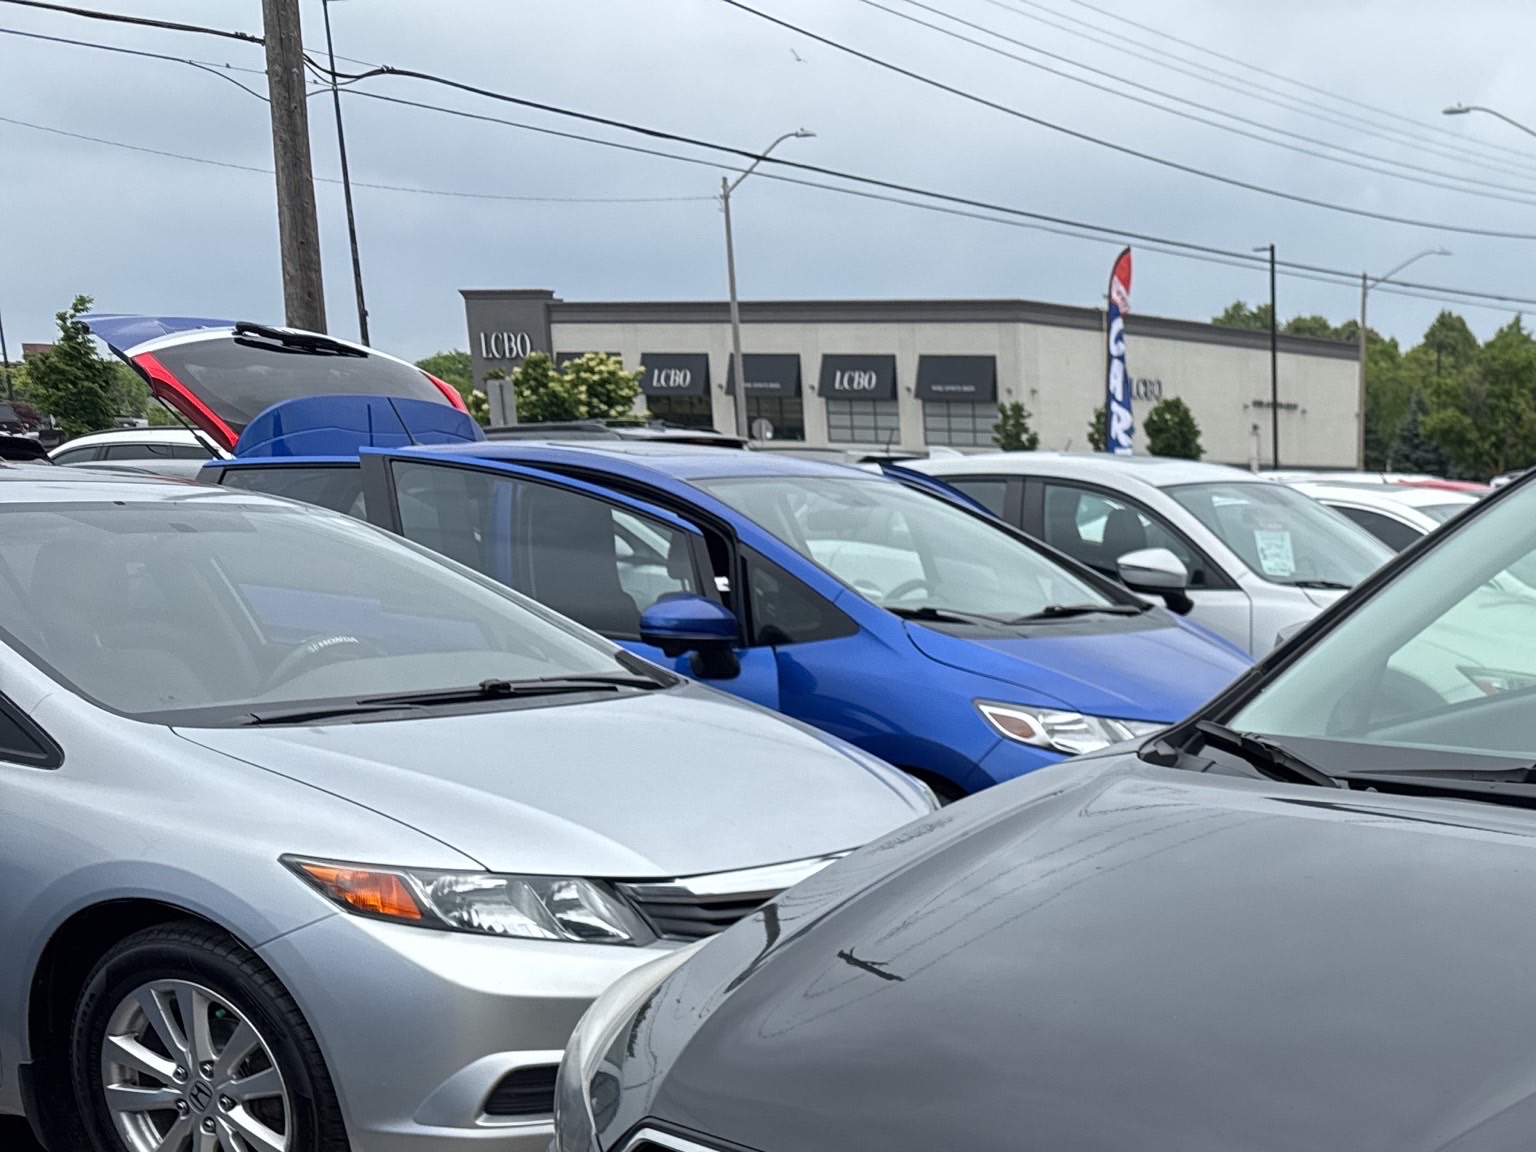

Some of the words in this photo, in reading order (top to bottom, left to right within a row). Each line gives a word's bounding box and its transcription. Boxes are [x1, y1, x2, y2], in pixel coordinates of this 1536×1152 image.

[480, 332, 531, 359] LCBO
[652, 368, 691, 388] LCBO
[834, 369, 877, 391] LCBO
[317, 635, 359, 648] HONDA
